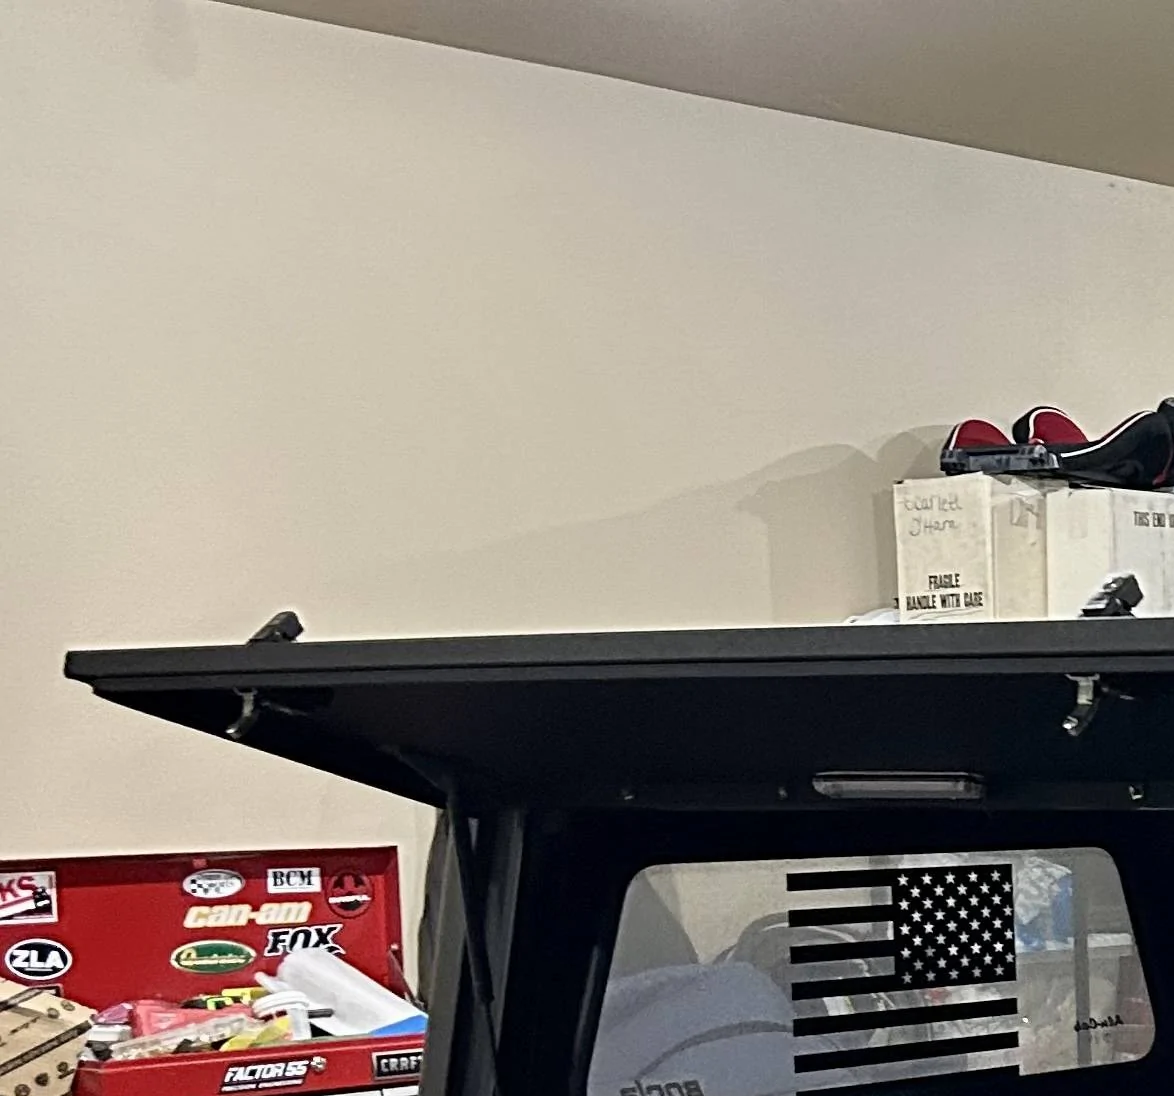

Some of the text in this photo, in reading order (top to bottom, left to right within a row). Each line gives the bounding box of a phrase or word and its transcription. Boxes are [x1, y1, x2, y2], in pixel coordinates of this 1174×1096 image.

[1133, 511, 1149, 527] THIS
[1152, 512, 1165, 528] END
[928, 573, 960, 590] FRAGILE
[906, 592, 983, 611] HANDLE WITH CARE
[272, 870, 314, 888] BCM
[266, 925, 342, 955] FOX
[12, 949, 65, 969] ZLA
[223, 1060, 310, 1083] FACTOR 55
